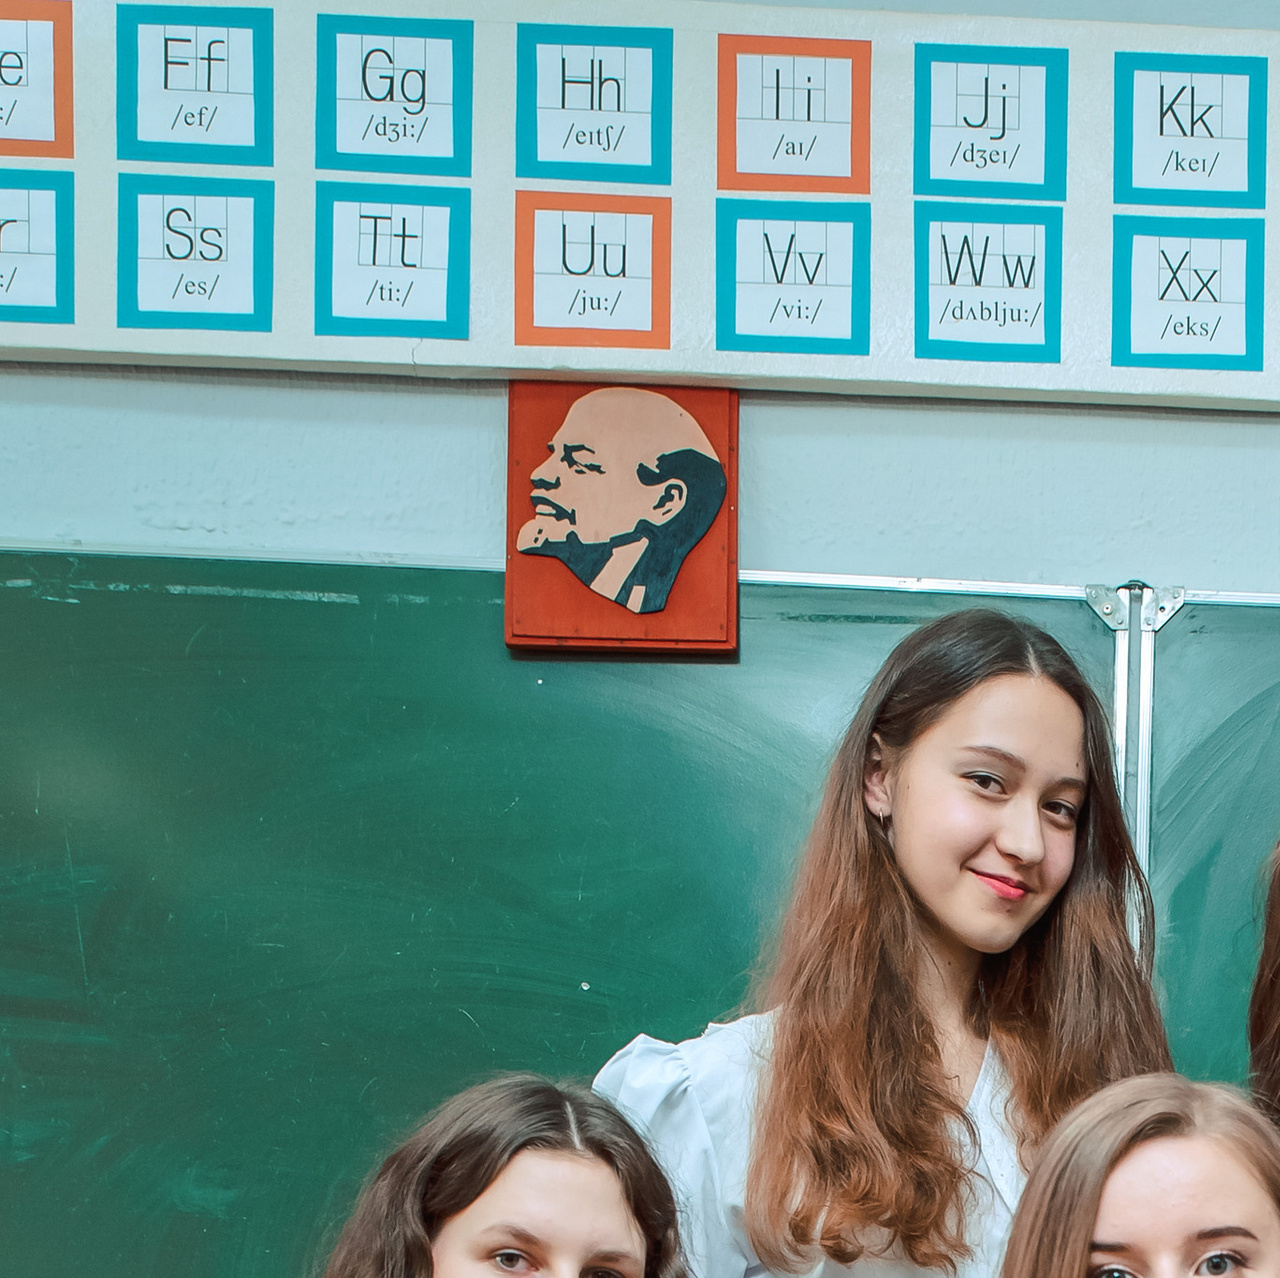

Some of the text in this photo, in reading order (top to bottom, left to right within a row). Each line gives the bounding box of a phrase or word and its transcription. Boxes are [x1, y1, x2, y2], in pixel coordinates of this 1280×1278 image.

[165, 38, 224, 91] Ff
[362, 49, 425, 114] Gg
[562, 58, 620, 111] Hh
[172, 105, 217, 131] /ef/
[964, 78, 1005, 139] Jj
[1160, 86, 1213, 137] Kk
[167, 209, 222, 260] Ss
[360, 216, 417, 267] Tt
[563, 225, 625, 277] Uu
[764, 234, 823, 284] Vv
[174, 274, 219, 299] /es/
[1161, 251, 1217, 302] Xx
[1161, 315, 1221, 341] /eks/
